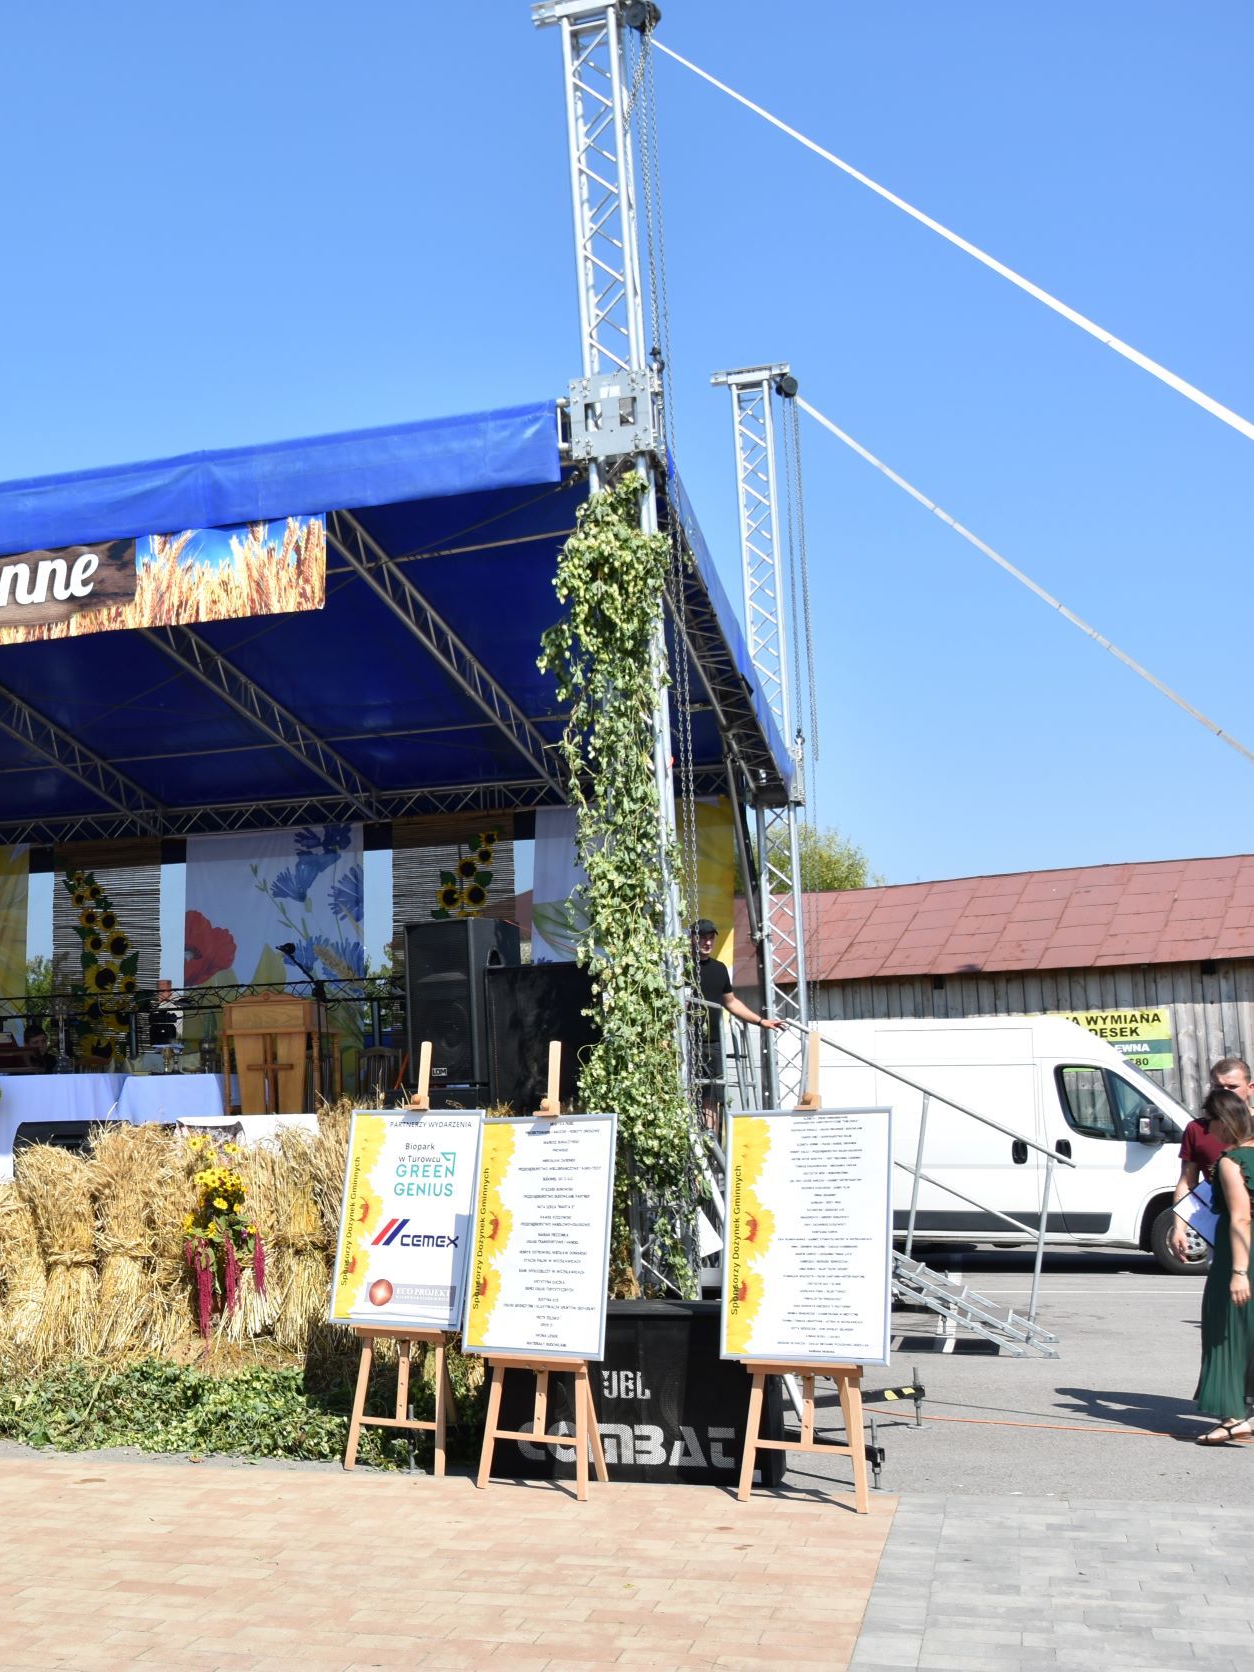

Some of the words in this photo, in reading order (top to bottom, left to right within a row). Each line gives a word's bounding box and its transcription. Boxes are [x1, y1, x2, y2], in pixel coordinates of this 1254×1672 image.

[1085, 1013, 1162, 1026] WYMIANA
[405, 1143, 435, 1151] Biopark
[407, 1155, 441, 1163] Turowcu
[396, 1159, 455, 1178] GREEN
[394, 1182, 453, 1197] GENIUS
[733, 1165, 744, 1215] Gminnych
[341, 1240, 353, 1286] Sponsorzy
[350, 1156, 361, 1200] Gminnych
[400, 1234, 459, 1249] CEMEX
[472, 1260, 484, 1310] Sponsorzy
[480, 1167, 490, 1215] Gminnych
[732, 1219, 742, 1260] Dożynek
[730, 1262, 741, 1316] Sponsorzy
[602, 1370, 651, 1400] JBL
[516, 1420, 736, 1469] COMBAT
